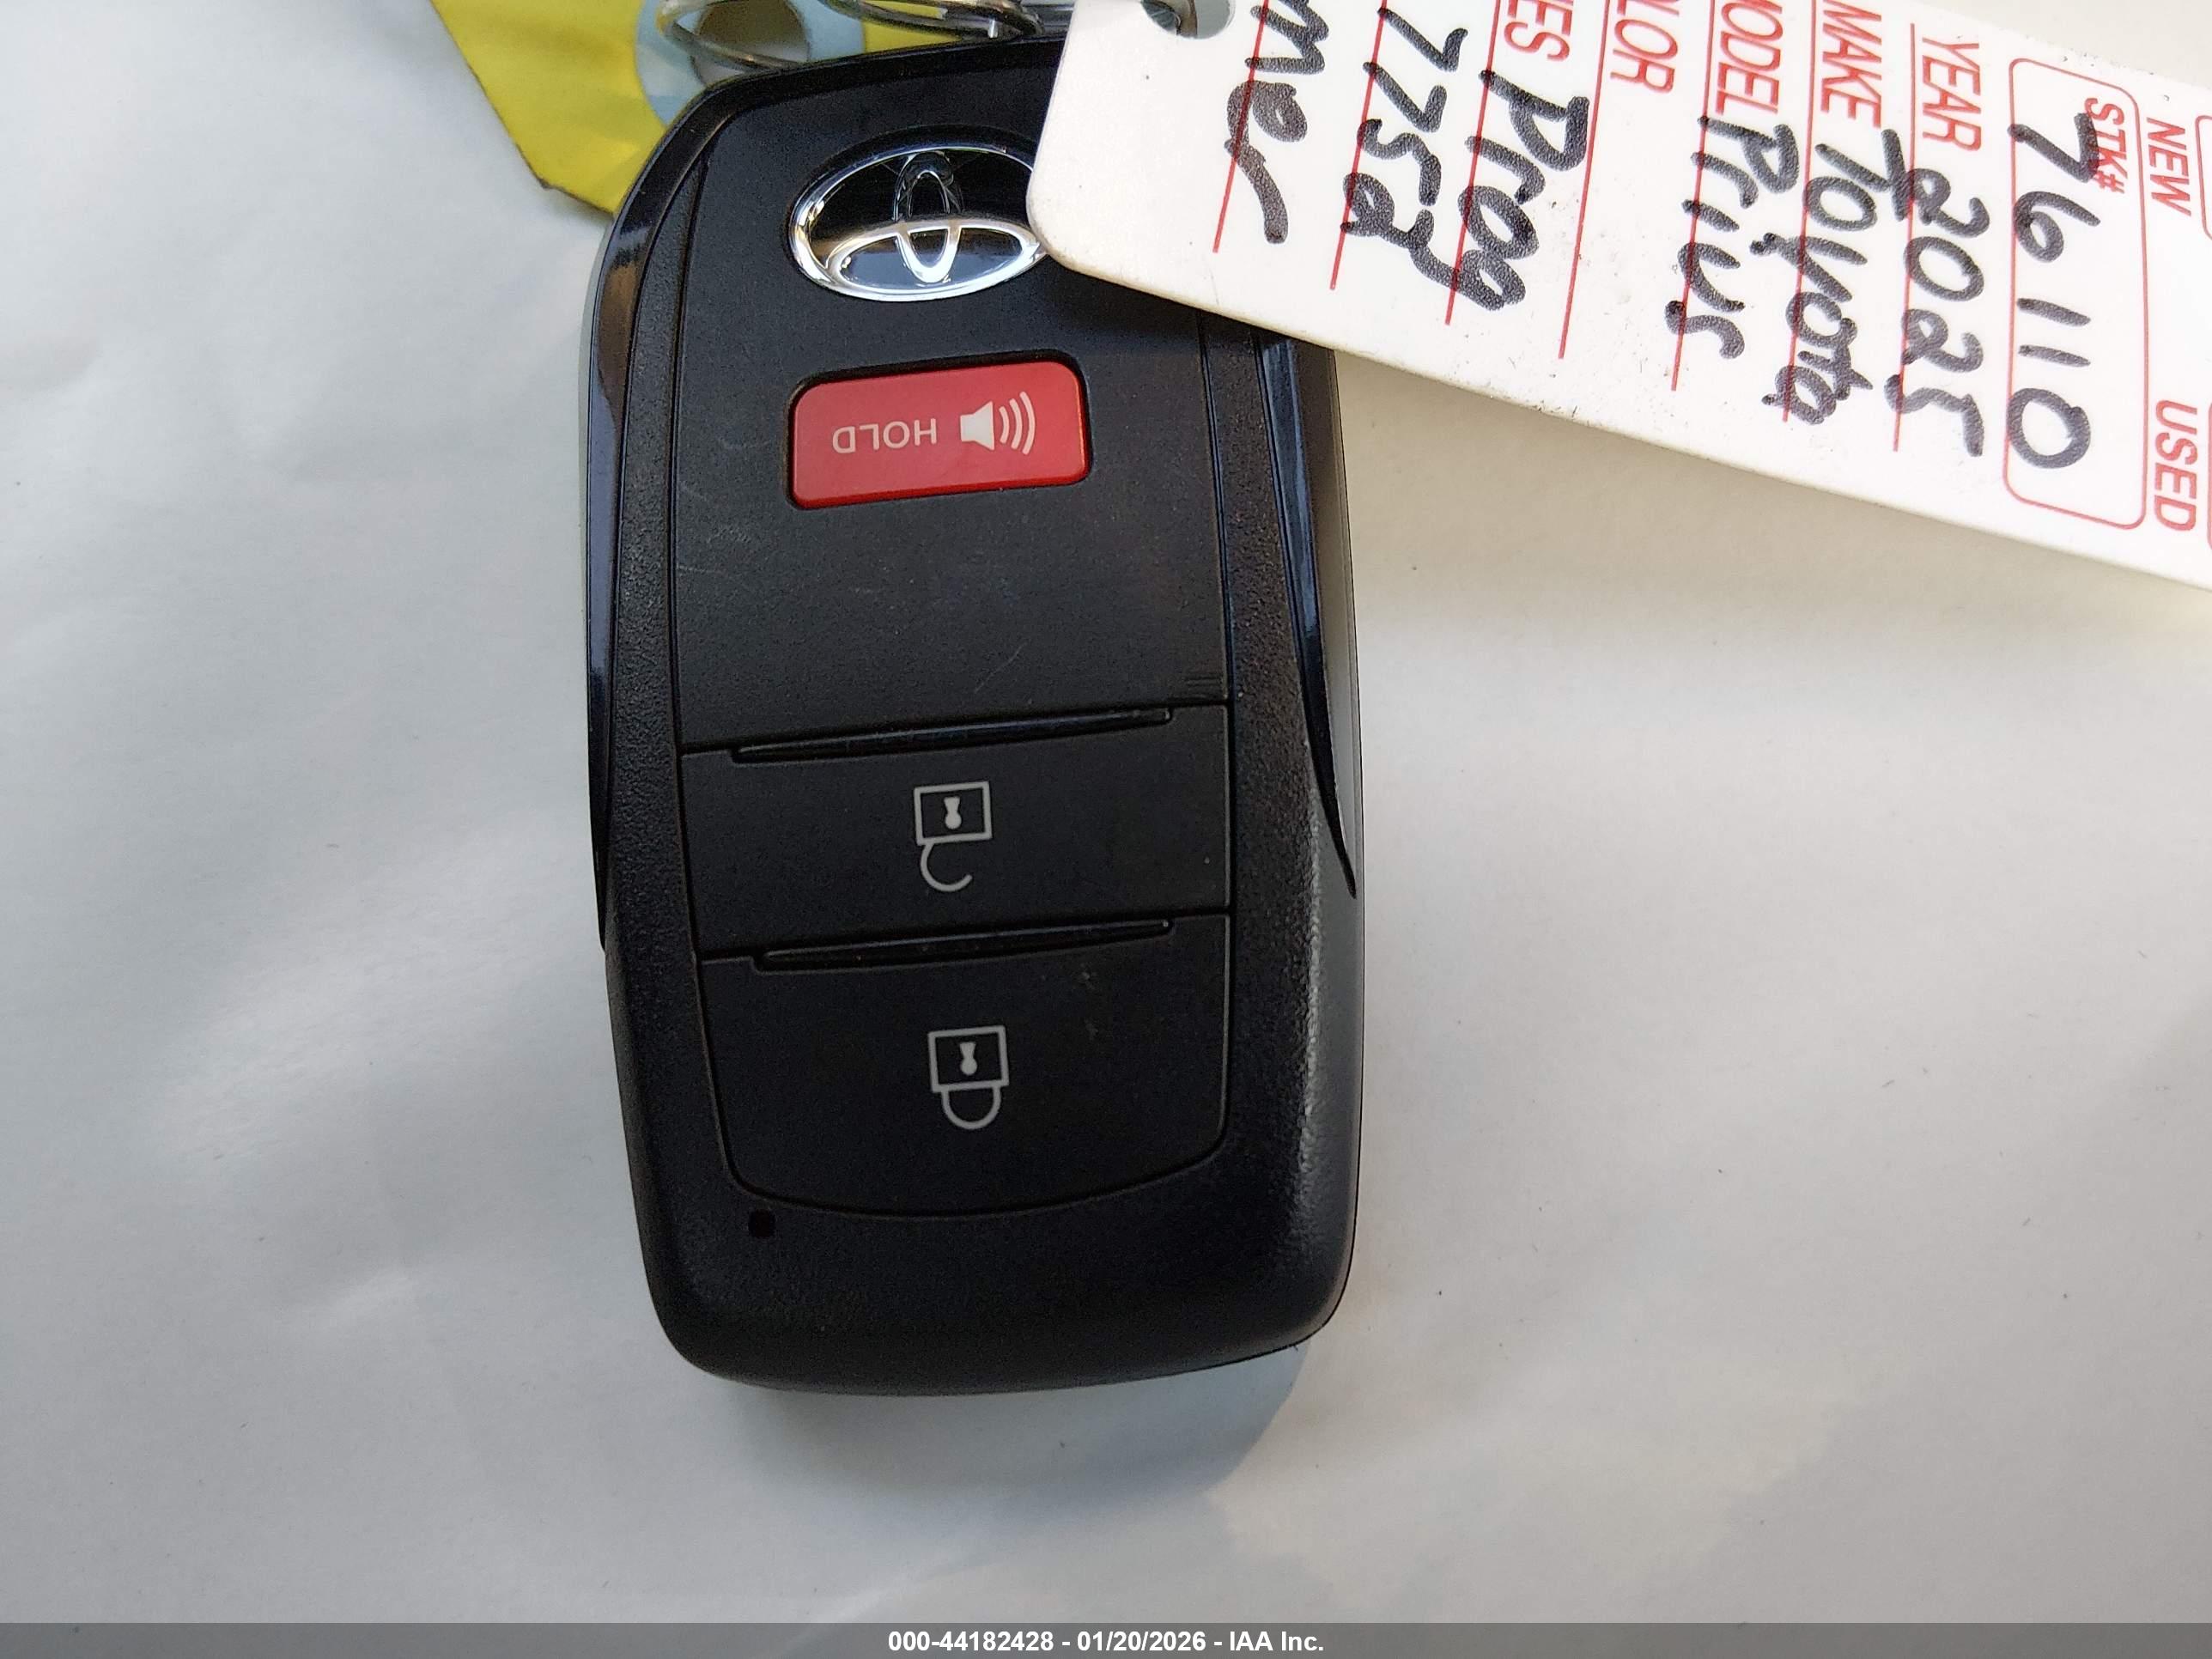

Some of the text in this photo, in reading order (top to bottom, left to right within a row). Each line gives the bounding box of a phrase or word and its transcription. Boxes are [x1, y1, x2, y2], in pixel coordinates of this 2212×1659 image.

[1609, 0, 1679, 94] LOR
[1716, 0, 1784, 115] ODEL
[1821, 0, 1881, 128] MAKE
[1922, 39, 1982, 152] YEAR
[2147, 118, 2191, 216] NEW
[1665, 115, 1799, 358] Prius
[1750, 129, 1909, 424] Toyota
[2006, 112, 2101, 469] 76110
[1884, 168, 1990, 456] 2025
[832, 418, 937, 454] HOLD
[2154, 399, 2198, 532] USED
